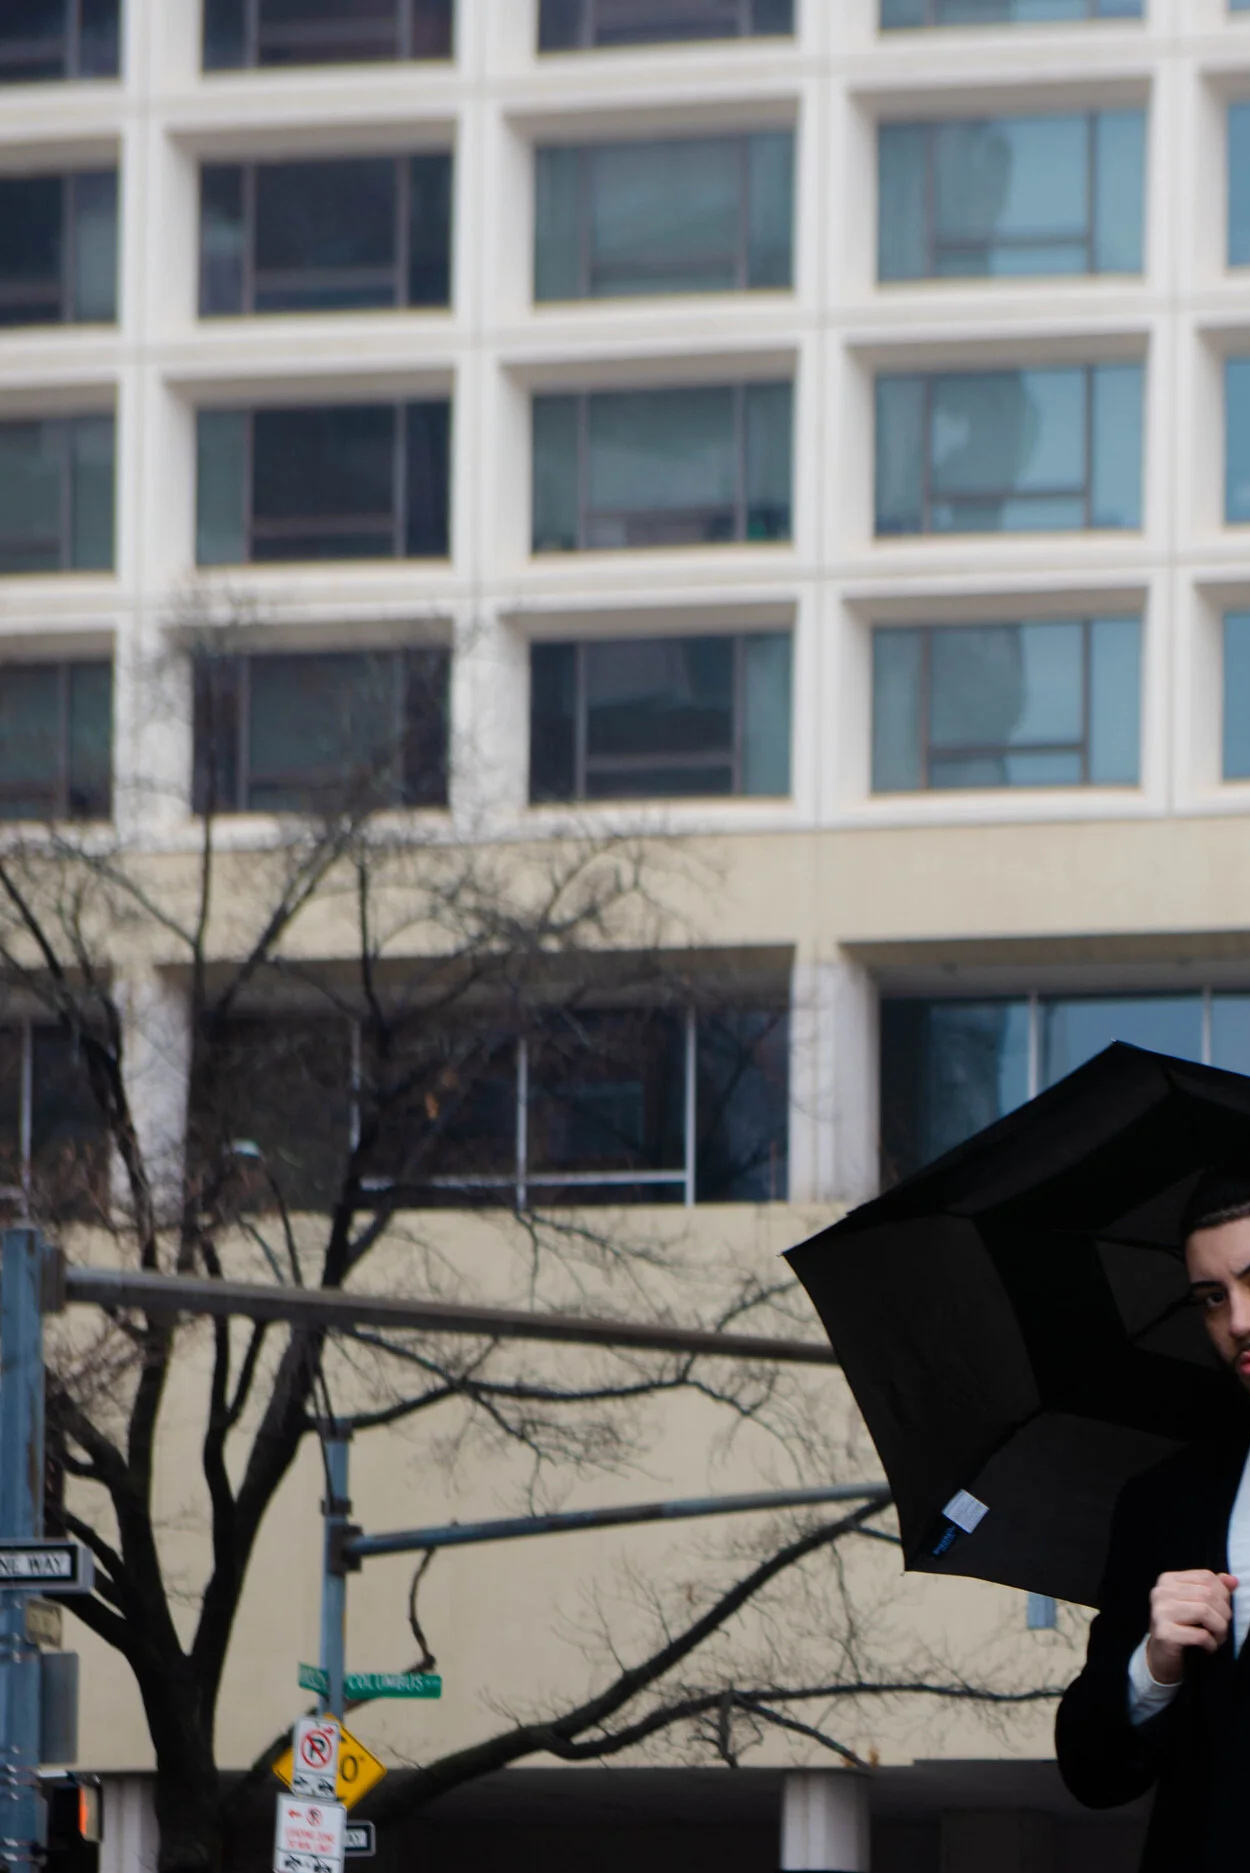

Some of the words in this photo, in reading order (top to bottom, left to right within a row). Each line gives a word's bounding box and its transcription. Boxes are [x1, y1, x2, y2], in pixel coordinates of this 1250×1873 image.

[0, 1556, 18, 1575] NE
[29, 1556, 64, 1575] WAY
[347, 1673, 424, 1691] COLUMBUS
